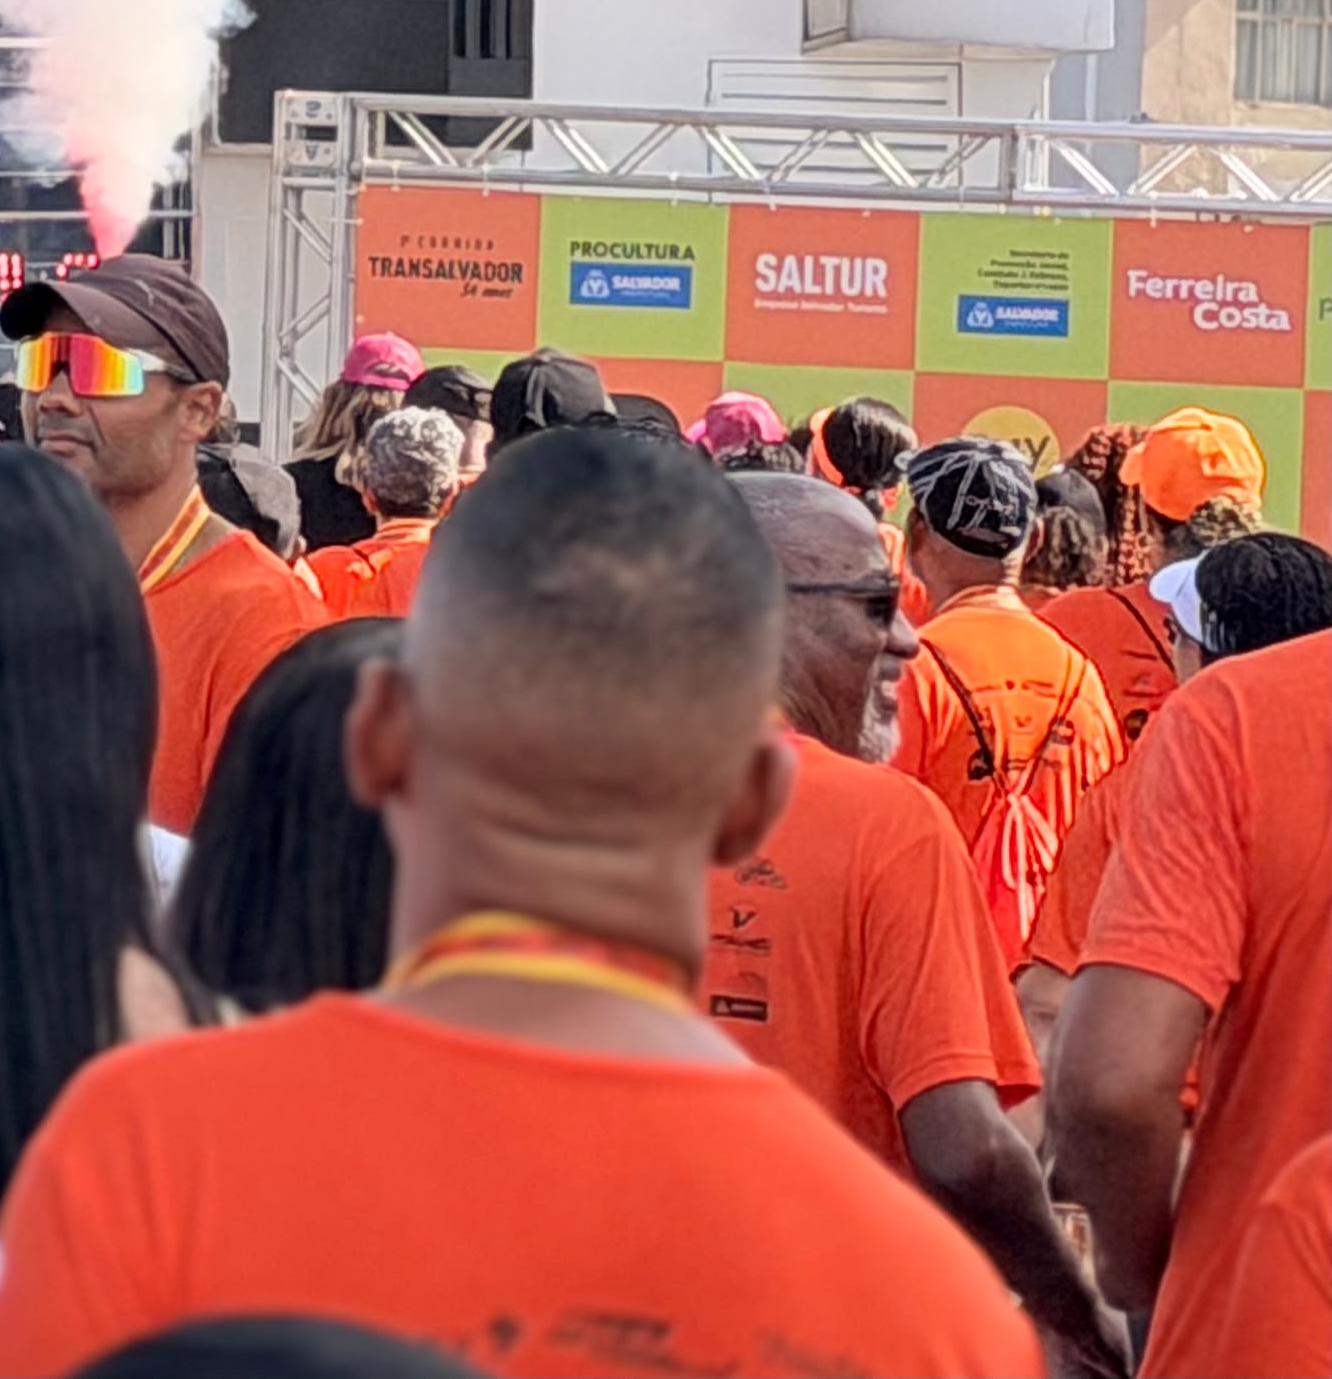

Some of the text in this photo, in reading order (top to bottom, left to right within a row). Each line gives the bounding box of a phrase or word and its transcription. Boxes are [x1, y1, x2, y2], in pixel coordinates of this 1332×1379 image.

[569, 240, 696, 261] PROCULTURA
[368, 256, 524, 284] TRANSALVADOR
[612, 275, 681, 292] SALVADOR
[754, 253, 889, 299] SALTUR
[1127, 268, 1259, 303] Ferreira
[994, 306, 1060, 323] SALVADOR
[1192, 302, 1293, 331] Costa
